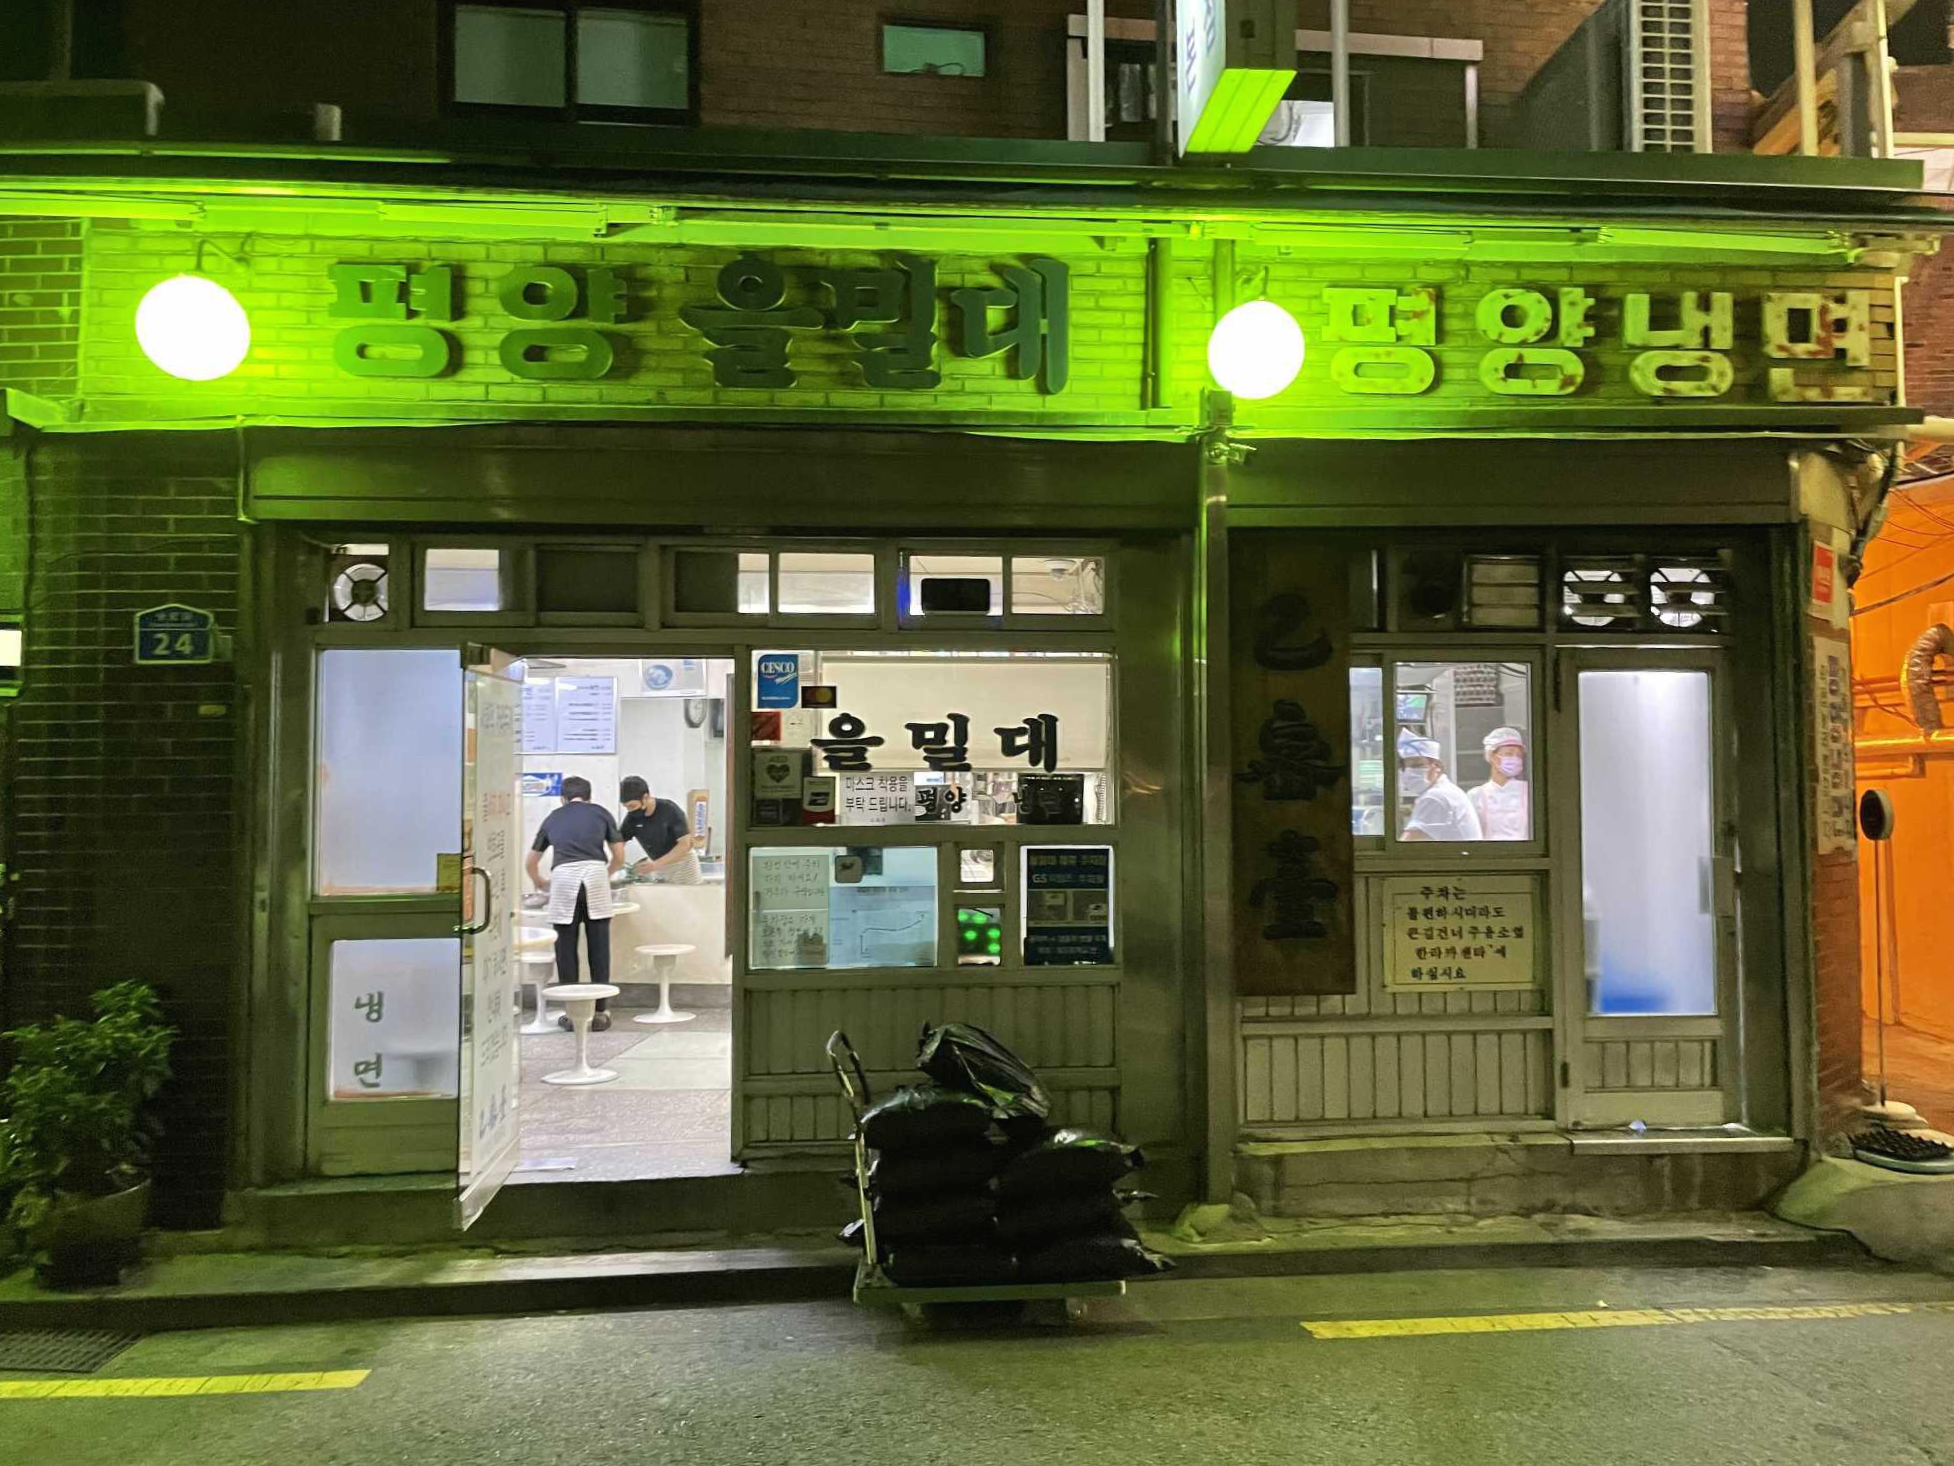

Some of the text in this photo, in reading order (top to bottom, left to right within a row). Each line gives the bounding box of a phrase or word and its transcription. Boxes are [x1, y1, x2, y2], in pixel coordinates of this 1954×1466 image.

[329, 250, 1070, 395] 평양 을밀대
[1321, 286, 1872, 403] 평양냉면
[153, 632, 194, 655] 24
[760, 661, 795, 674] CESCO
[811, 712, 1058, 773] 을밀대
[845, 776, 874, 792] 마스크
[878, 776, 907, 792] 착용을
[845, 796, 865, 813] 부탁
[1420, 886, 1467, 901] 주차는
[354, 990, 385, 1088] 냉면
